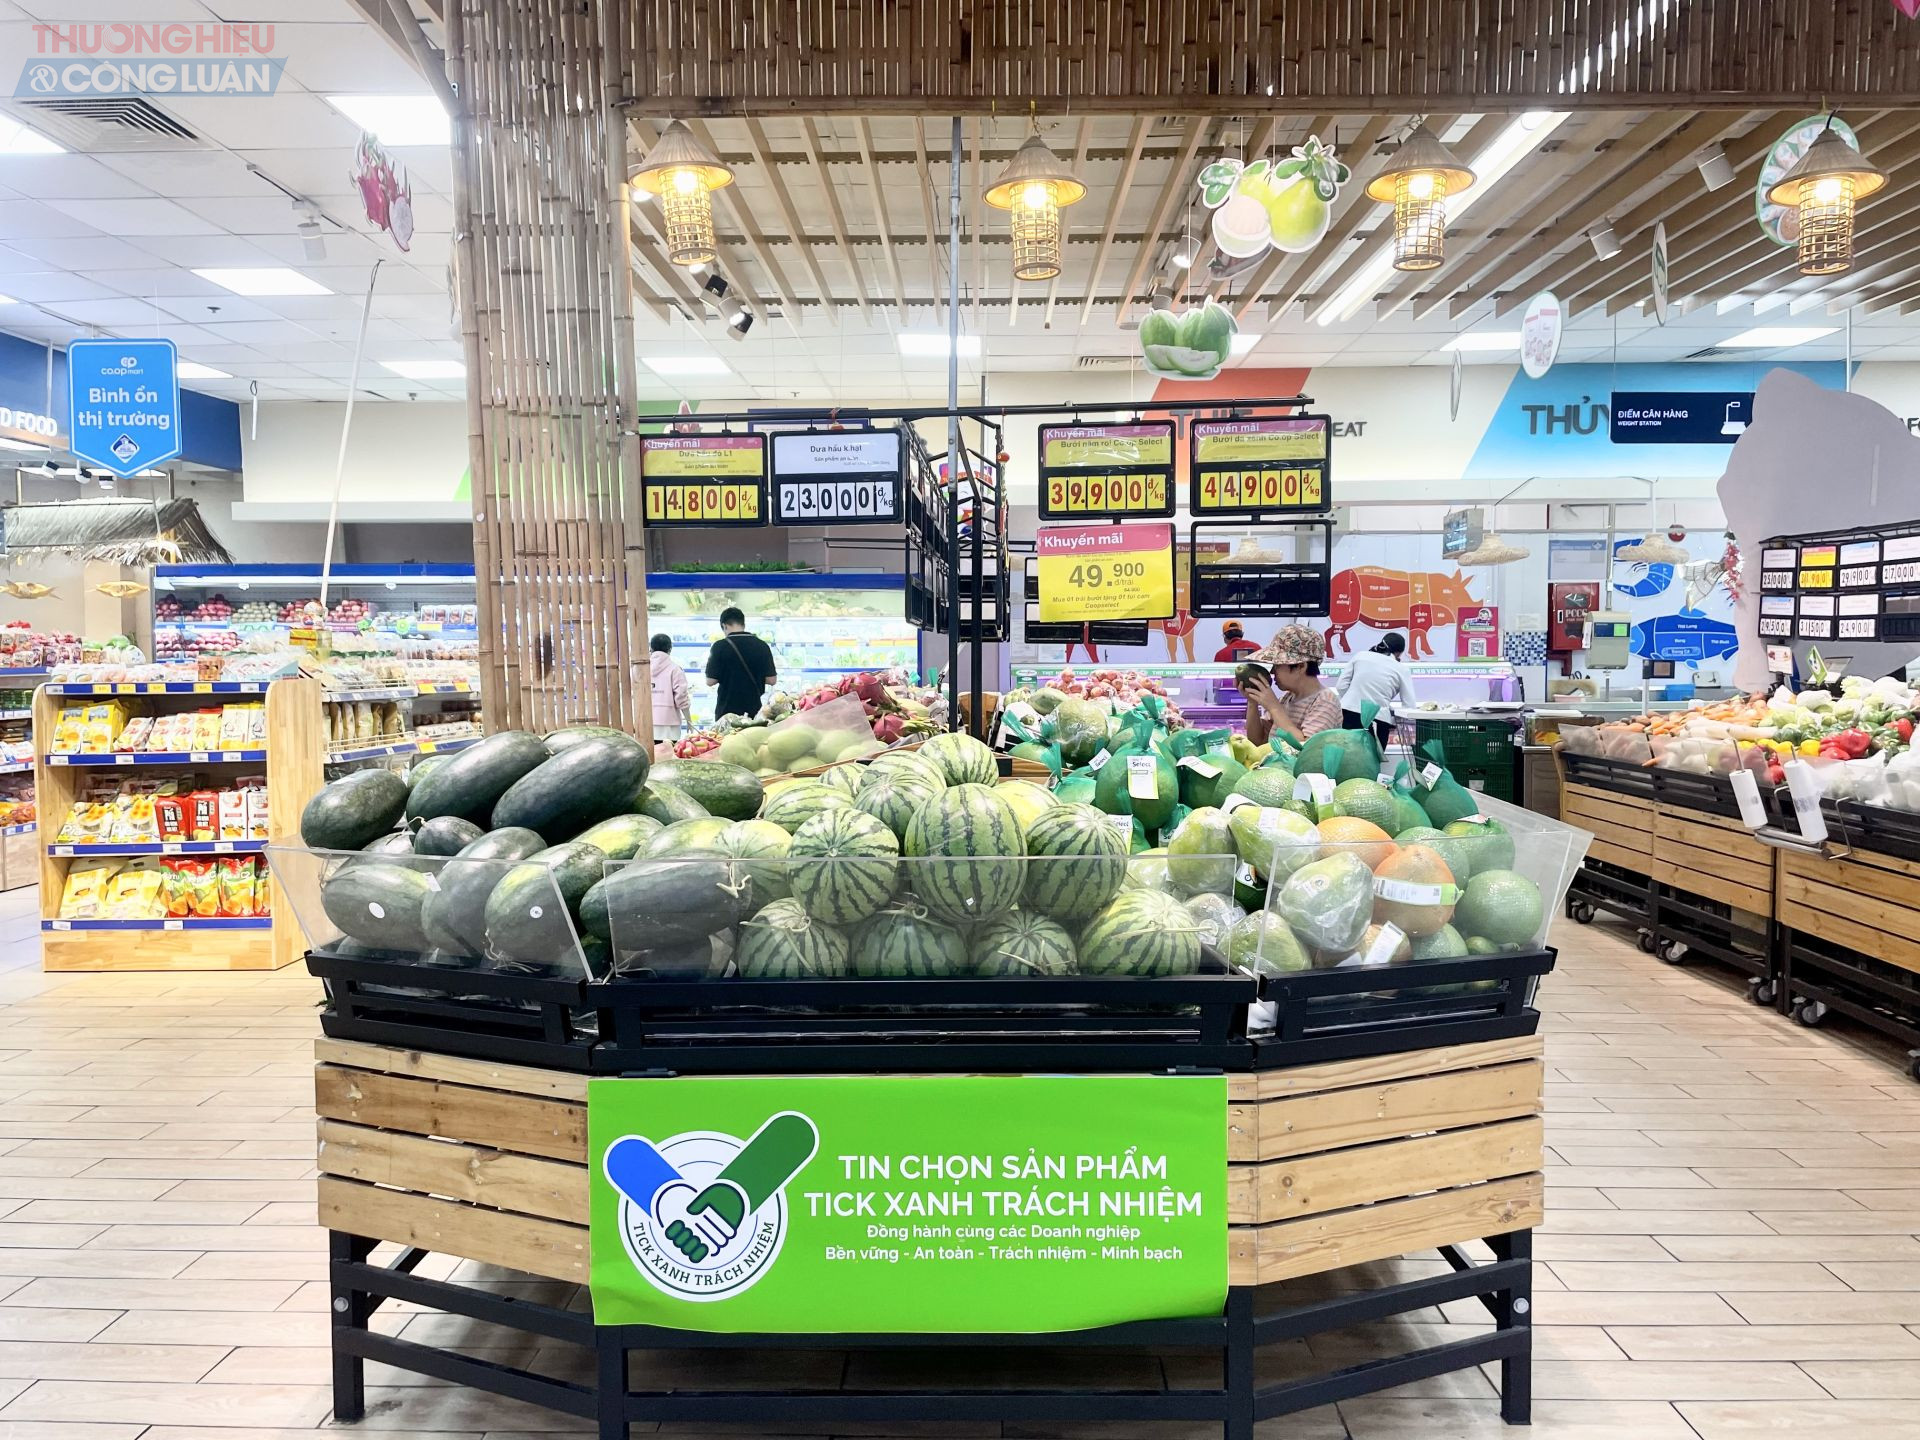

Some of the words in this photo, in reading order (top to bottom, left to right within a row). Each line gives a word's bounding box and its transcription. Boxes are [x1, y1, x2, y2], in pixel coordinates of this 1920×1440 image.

[89, 387, 130, 403] Bình
[134, 385, 158, 403] ổn
[78, 411, 103, 430] thị
[107, 411, 170, 430] trường
[1617, 408, 1641, 418] ĐIỂM
[1642, 408, 1661, 418] CÂN
[1663, 408, 1689, 418] HÀNG
[16, 410, 58, 437] FOOD
[1199, 423, 1238, 435] Khuyến
[1241, 423, 1260, 433] mãi
[1046, 428, 1085, 440] Khuyến
[810, 445, 827, 453] Dưa
[828, 444, 842, 453] hấu
[1051, 480, 1142, 505] 39.900
[1204, 475, 1297, 498] 44.900
[1303, 472, 1320, 497] đ/kg
[653, 489, 737, 512] 14.800
[784, 487, 870, 511] 23.000
[1044, 533, 1097, 549] Khuyến
[1098, 532, 1123, 545] mãi
[838, 1155, 890, 1180] TIN
[899, 1155, 992, 1185] CHỌN
[1001, 1148, 1066, 1180] SẢN
[1076, 1146, 1167, 1180] PHẨM
[804, 1192, 877, 1217] TICK
[884, 1192, 973, 1217] XANH
[982, 1185, 1089, 1217] TRÁCH
[1099, 1186, 1202, 1223] NHIỆM
[867, 1224, 909, 1242] Đồng
[912, 1224, 952, 1238] hành
[955, 1225, 995, 1241] cùng
[998, 1224, 1027, 1238] các
[1031, 1224, 1082, 1238] Doanh
[1085, 1224, 1141, 1242] nghiệp
[633, 1222, 655, 1256] TICK
[651, 1253, 690, 1284] XANH
[694, 1264, 744, 1286] TRÁCH
[746, 1221, 775, 1268] NHIỆM
[825, 1246, 856, 1260] Bền
[859, 1246, 899, 1264] vững
[913, 1246, 935, 1260] An
[938, 1246, 974, 1260] toàn
[988, 1246, 1034, 1260] Trách
[1037, 1246, 1087, 1262] nhiệm
[1101, 1246, 1140, 1260] Minh
[1143, 1246, 1183, 1262] bạch
